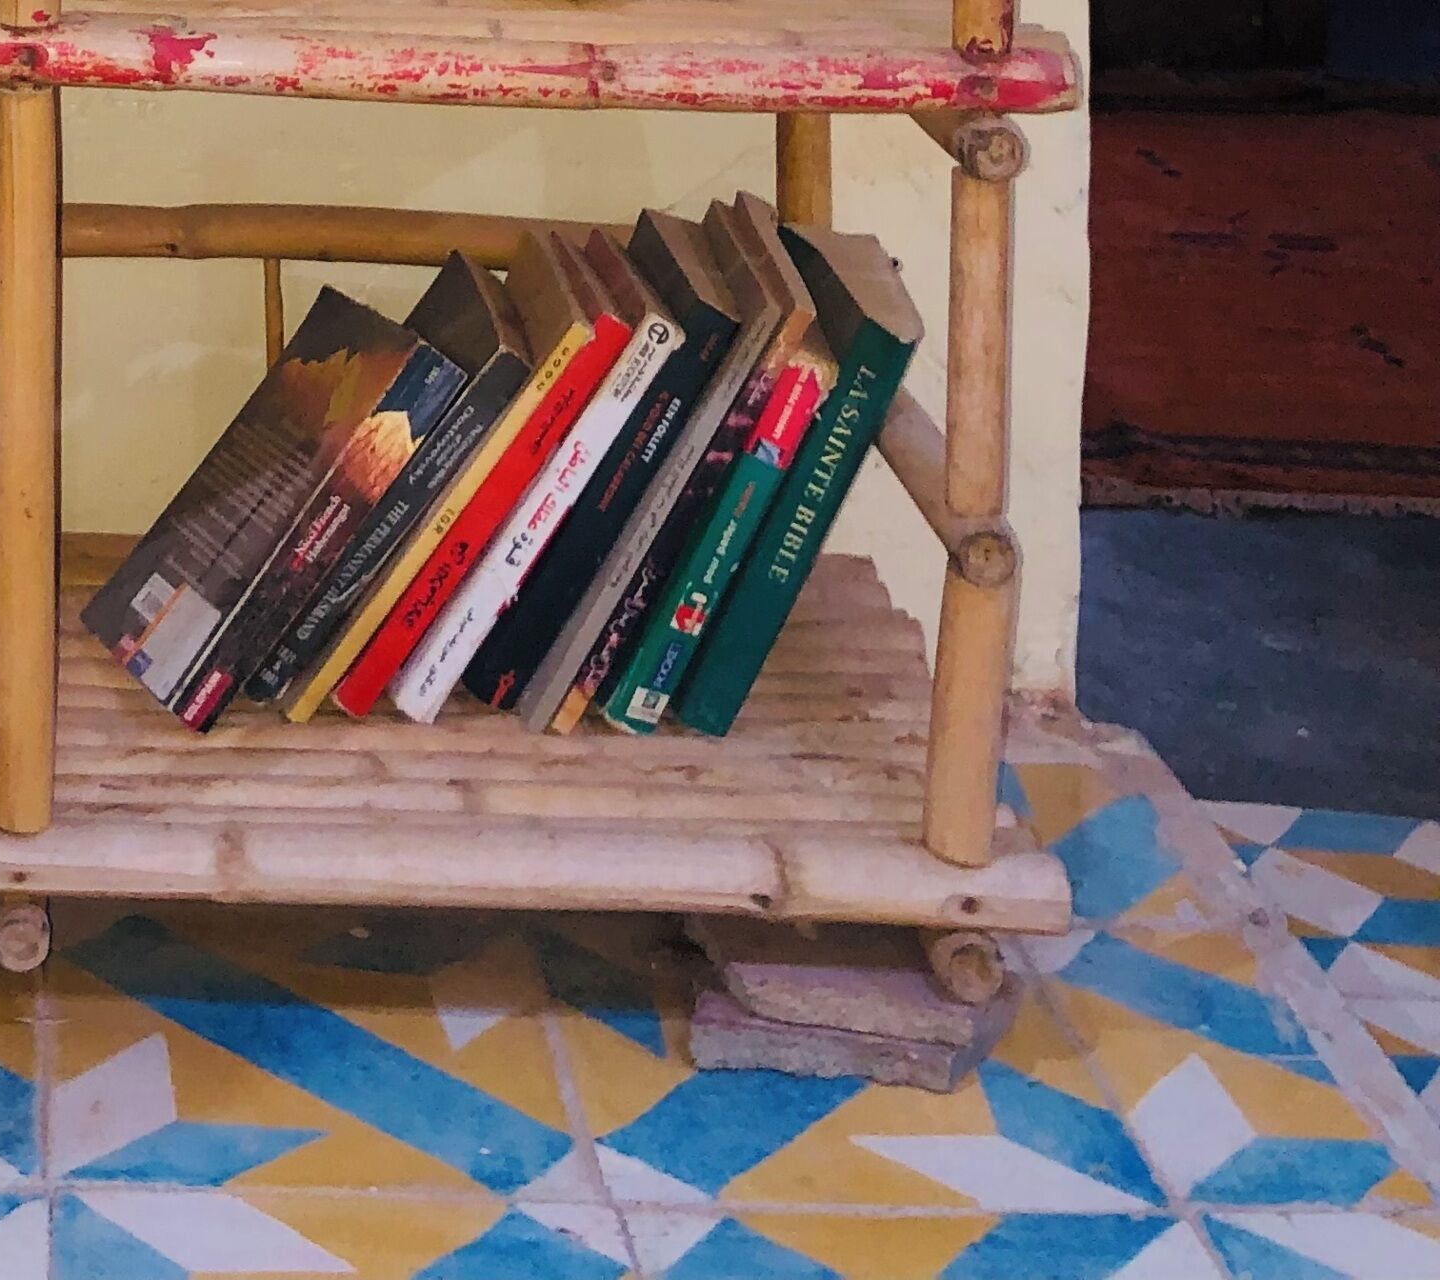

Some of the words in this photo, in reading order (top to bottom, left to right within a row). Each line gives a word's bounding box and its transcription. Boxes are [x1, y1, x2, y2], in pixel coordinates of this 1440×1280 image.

[662, 396, 683, 421] KEN
[846, 363, 877, 403] LA
[637, 418, 671, 463] FOLLETT
[802, 402, 860, 503] SAINTE
[384, 498, 409, 524] THE
[523, 490, 562, 534] عقلك
[546, 439, 596, 494] الباطن
[292, 526, 318, 557] Nicci
[310, 492, 342, 531] French
[333, 520, 390, 588] PERMANENT
[765, 503, 817, 585] BIBLE
[293, 584, 342, 641] HUSBAND
